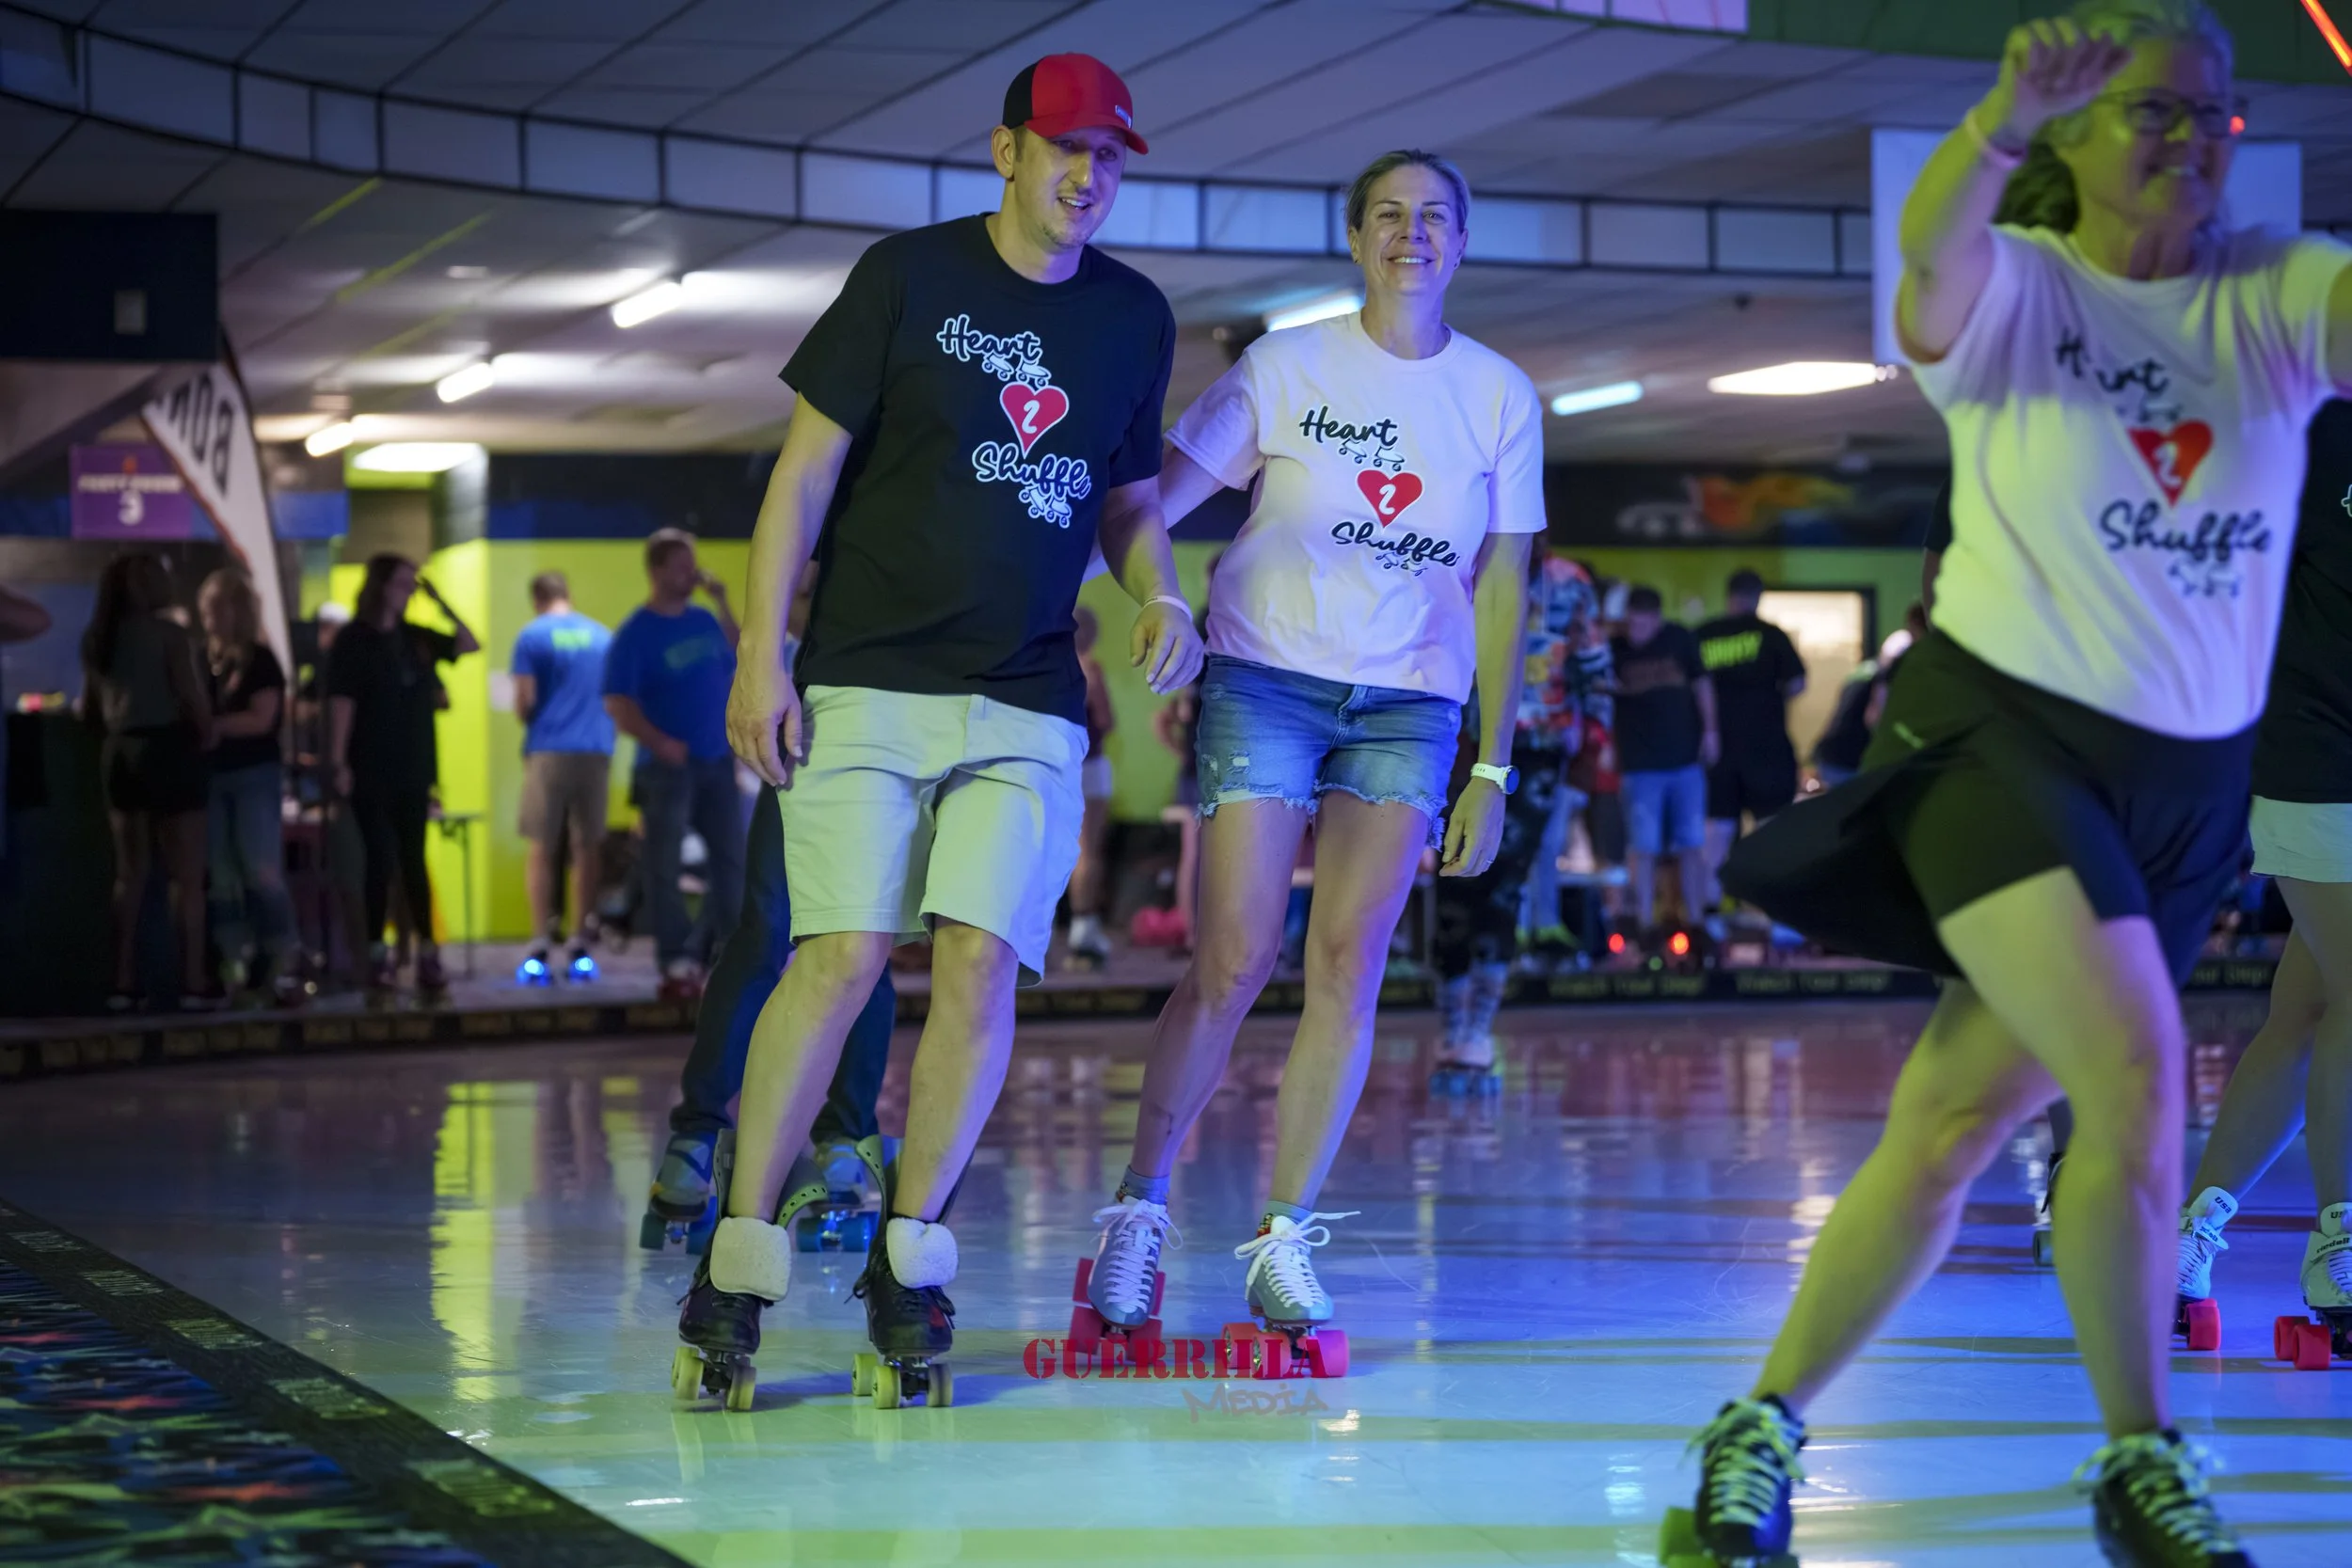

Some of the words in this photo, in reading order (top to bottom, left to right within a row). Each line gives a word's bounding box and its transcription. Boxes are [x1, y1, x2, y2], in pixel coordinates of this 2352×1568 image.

[937, 314, 1043, 361] Heart
[1022, 400, 1040, 434] 2
[1299, 405, 1399, 448] Heart
[972, 441, 1092, 499] Shuffle
[2152, 441, 2184, 487] 2
[1378, 483, 1397, 515] 2
[1331, 521, 1461, 567] Shuffle
